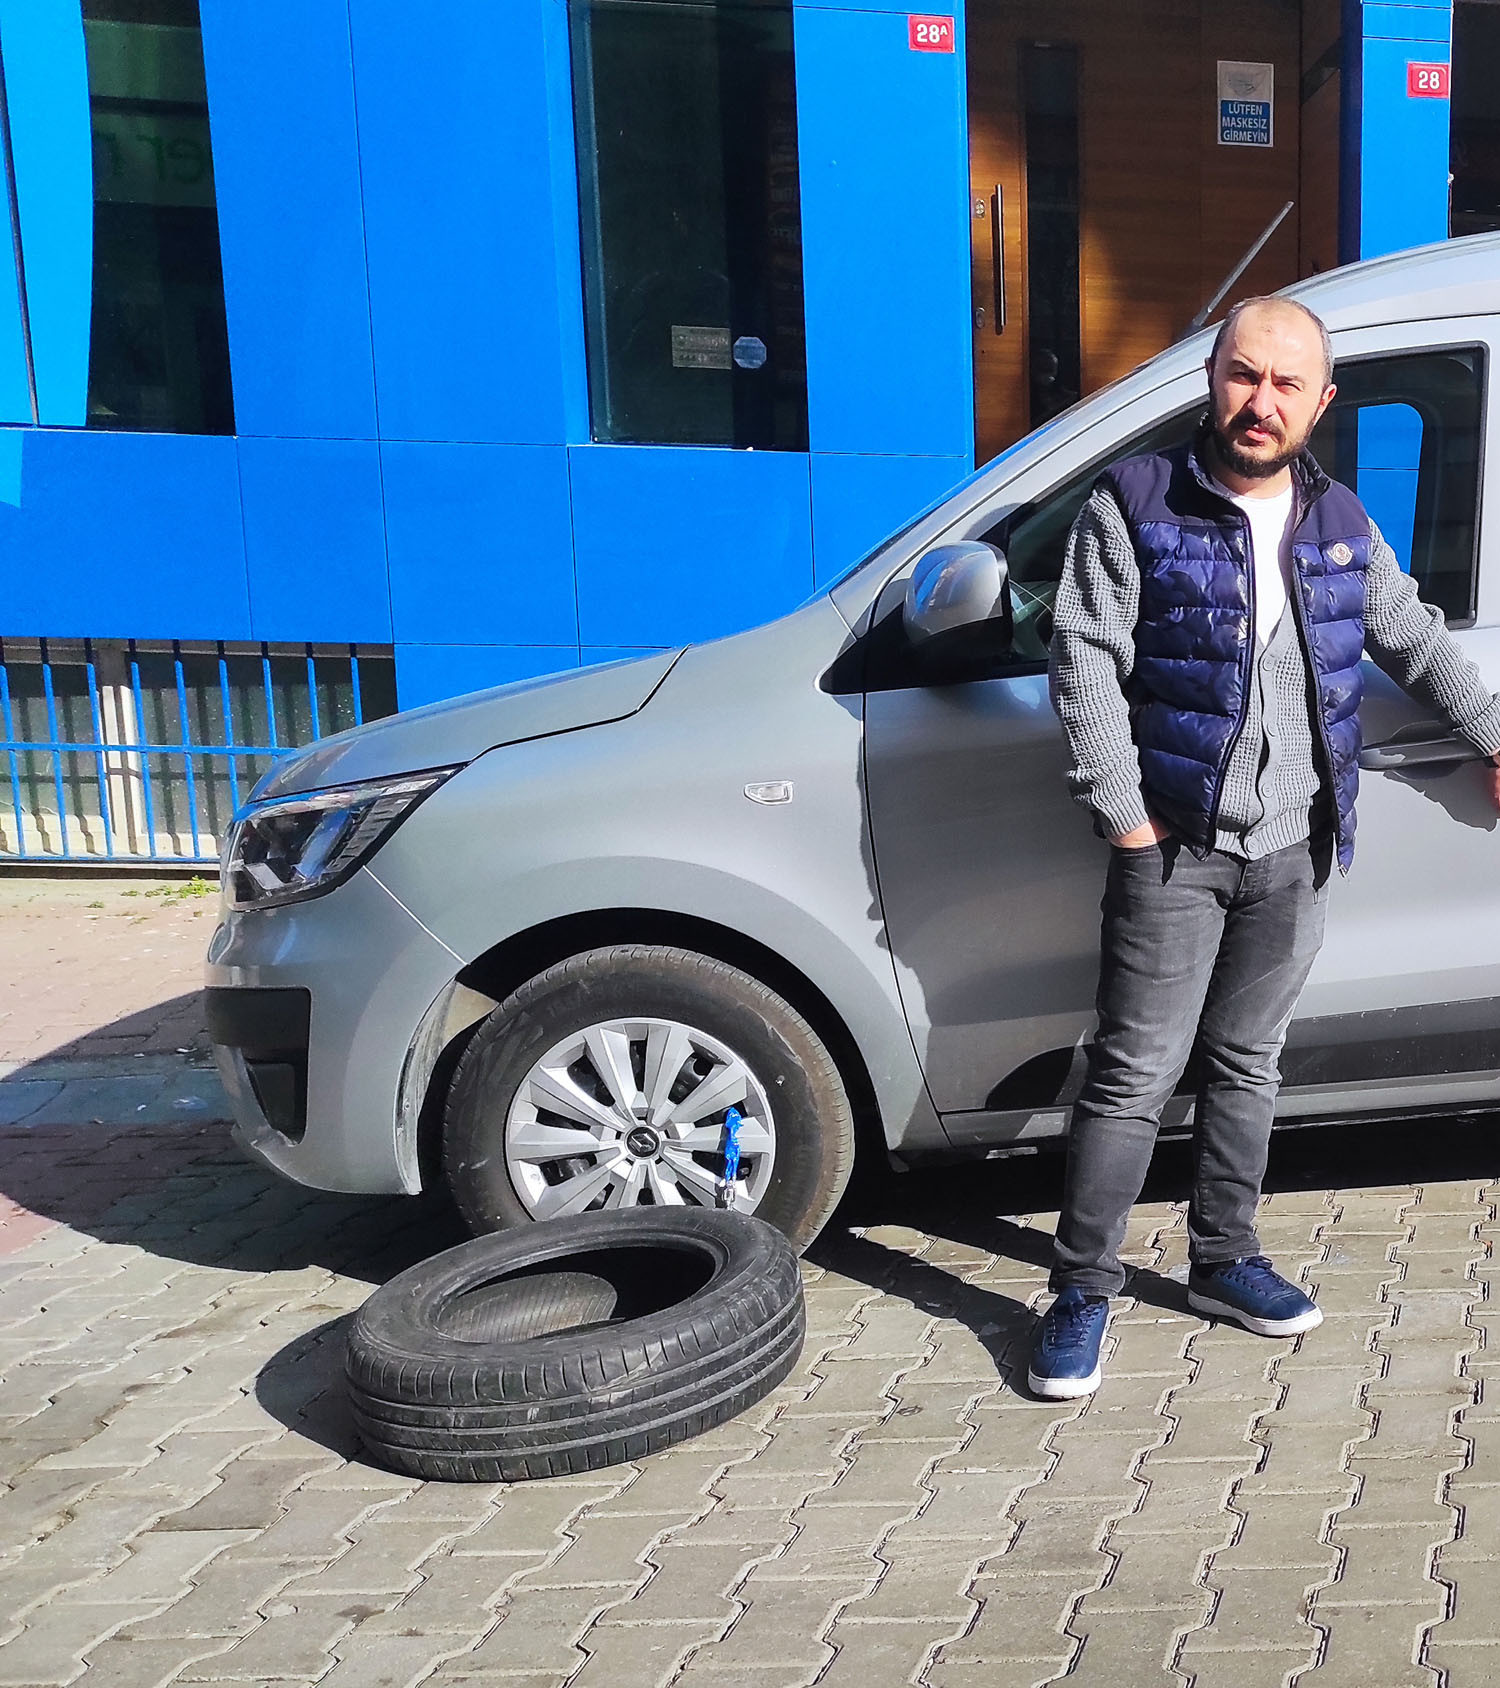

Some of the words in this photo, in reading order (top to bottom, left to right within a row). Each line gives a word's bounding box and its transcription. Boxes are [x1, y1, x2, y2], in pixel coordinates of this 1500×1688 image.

[1418, 70, 1440, 89] 28
[1228, 102, 1263, 115] LÜTFEN
[1222, 116, 1268, 129] MASKESİZ
[1223, 129, 1268, 143] GİRMEYİN
